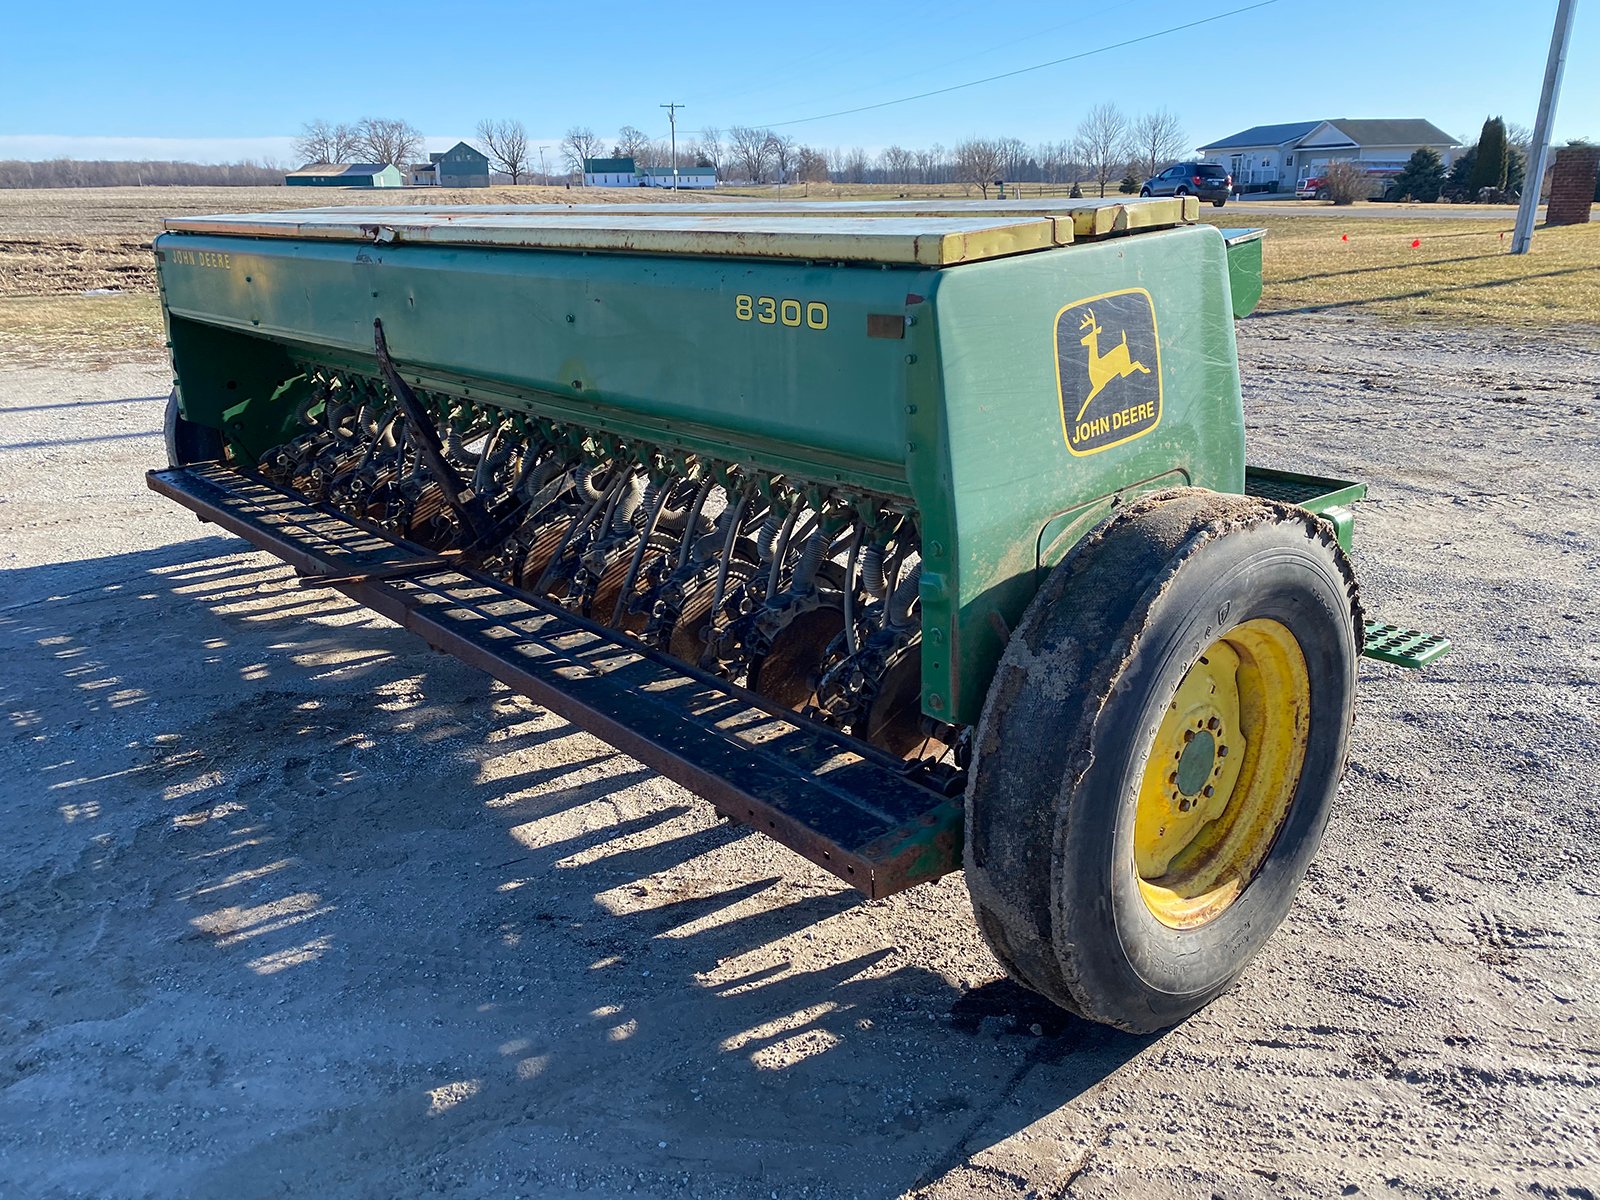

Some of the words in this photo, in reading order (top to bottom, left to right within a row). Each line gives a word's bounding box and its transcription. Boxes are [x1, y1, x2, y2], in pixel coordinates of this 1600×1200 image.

[172, 250, 195, 265] JOHN
[199, 253, 231, 269] DEERE
[735, 294, 829, 330] 8300
[1072, 415, 1110, 444] JOHN
[1112, 400, 1155, 430] DEERE
